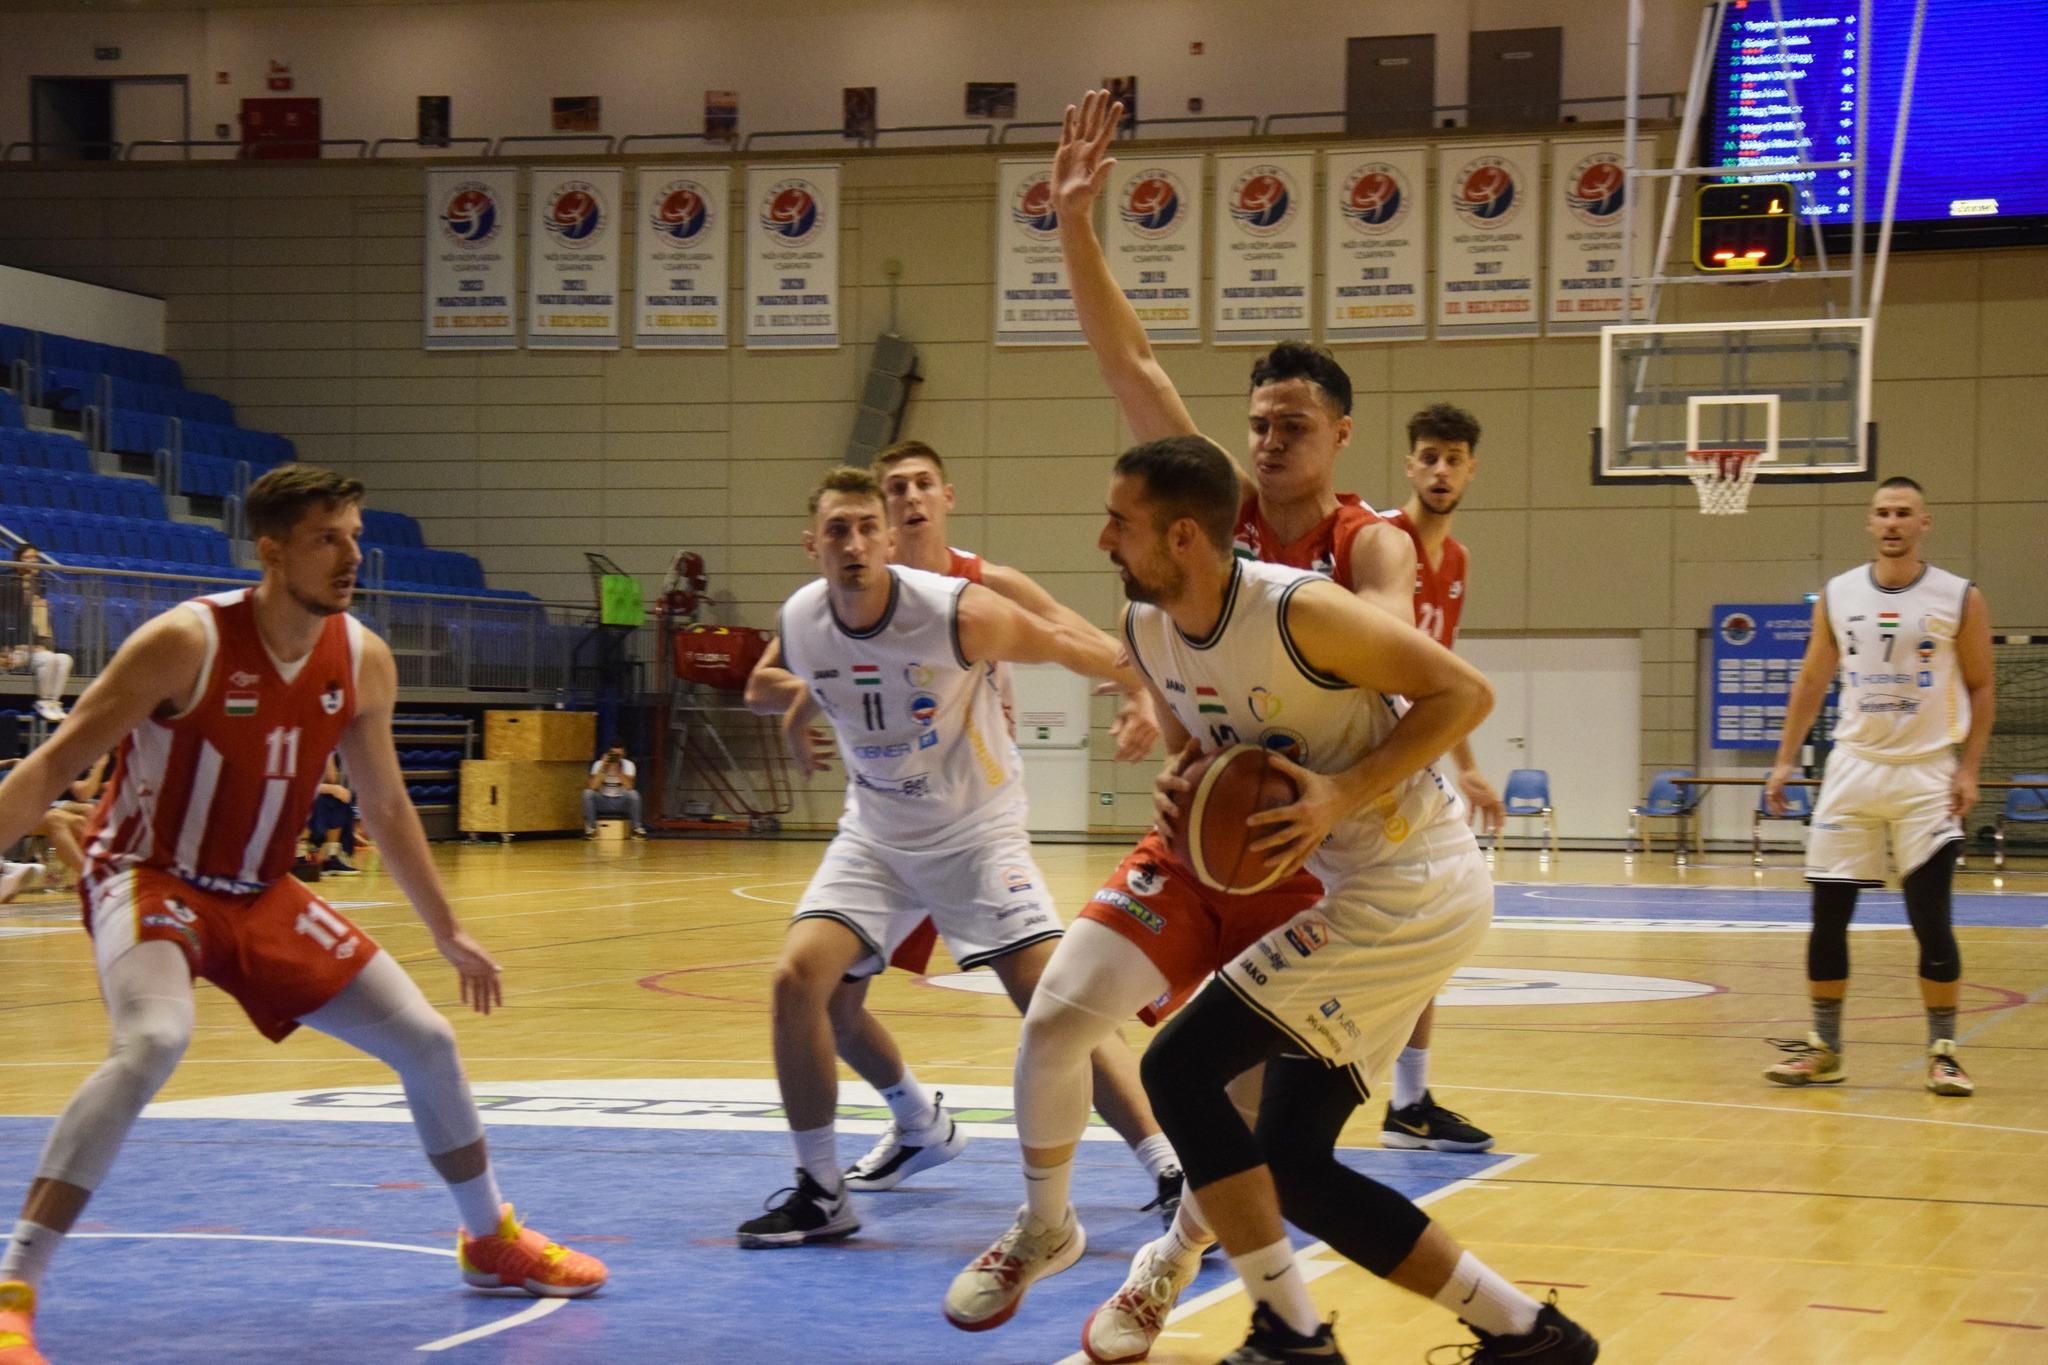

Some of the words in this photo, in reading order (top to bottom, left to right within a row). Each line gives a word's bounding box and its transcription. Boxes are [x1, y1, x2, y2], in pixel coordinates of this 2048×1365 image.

[1418, 602, 1445, 642] 21
[1880, 633, 1896, 663] 7
[1165, 677, 1187, 695] JAKO
[862, 692, 886, 731] 11
[265, 726, 302, 777] 11
[294, 900, 350, 949] 11
[1239, 958, 1269, 986] JAKO
